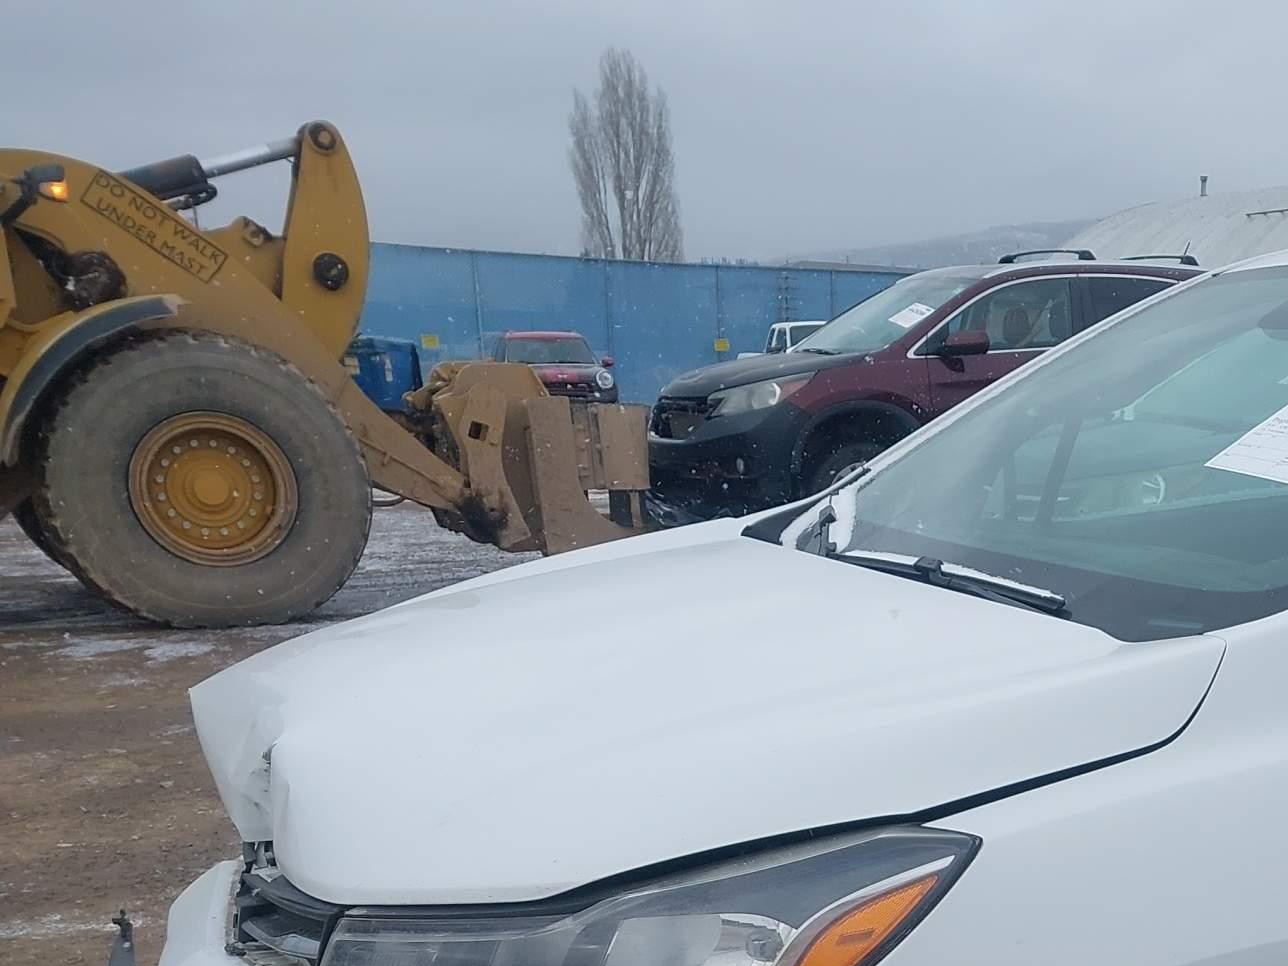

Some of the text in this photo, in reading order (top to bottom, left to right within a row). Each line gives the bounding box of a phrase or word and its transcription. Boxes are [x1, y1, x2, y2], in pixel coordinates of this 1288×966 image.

[95, 174, 223, 266] DO NOT WALK
[96, 198, 210, 275] UNDER MAST
